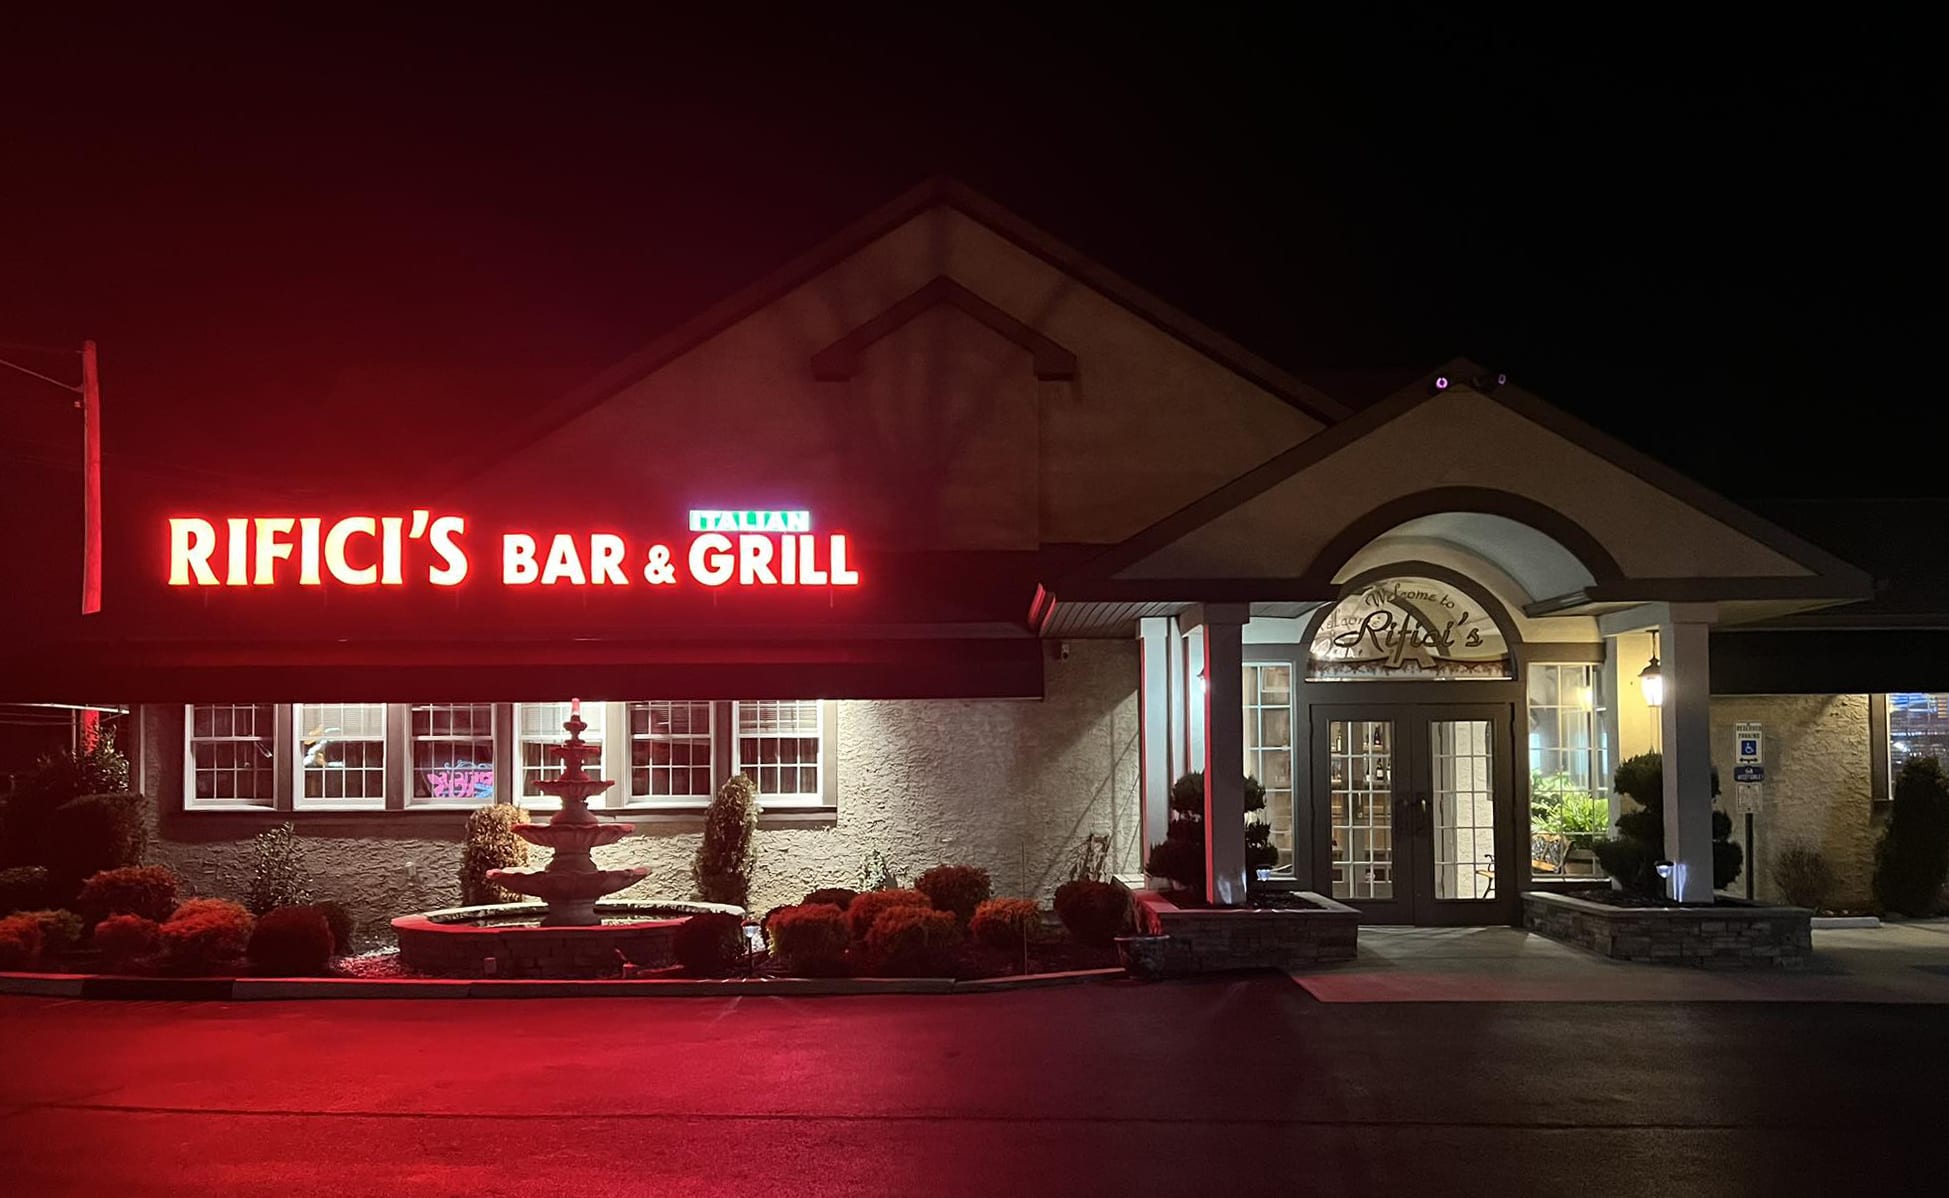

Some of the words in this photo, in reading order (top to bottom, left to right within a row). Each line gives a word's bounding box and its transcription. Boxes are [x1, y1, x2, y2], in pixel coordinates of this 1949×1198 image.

[689, 510, 809, 531] ITALIAN
[168, 510, 469, 586] RIFICI'S
[503, 533, 629, 585] BAR
[643, 544, 677, 585] &
[688, 533, 859, 586] GRILL
[1365, 582, 1437, 607] Welcome
[1440, 594, 1455, 609] to
